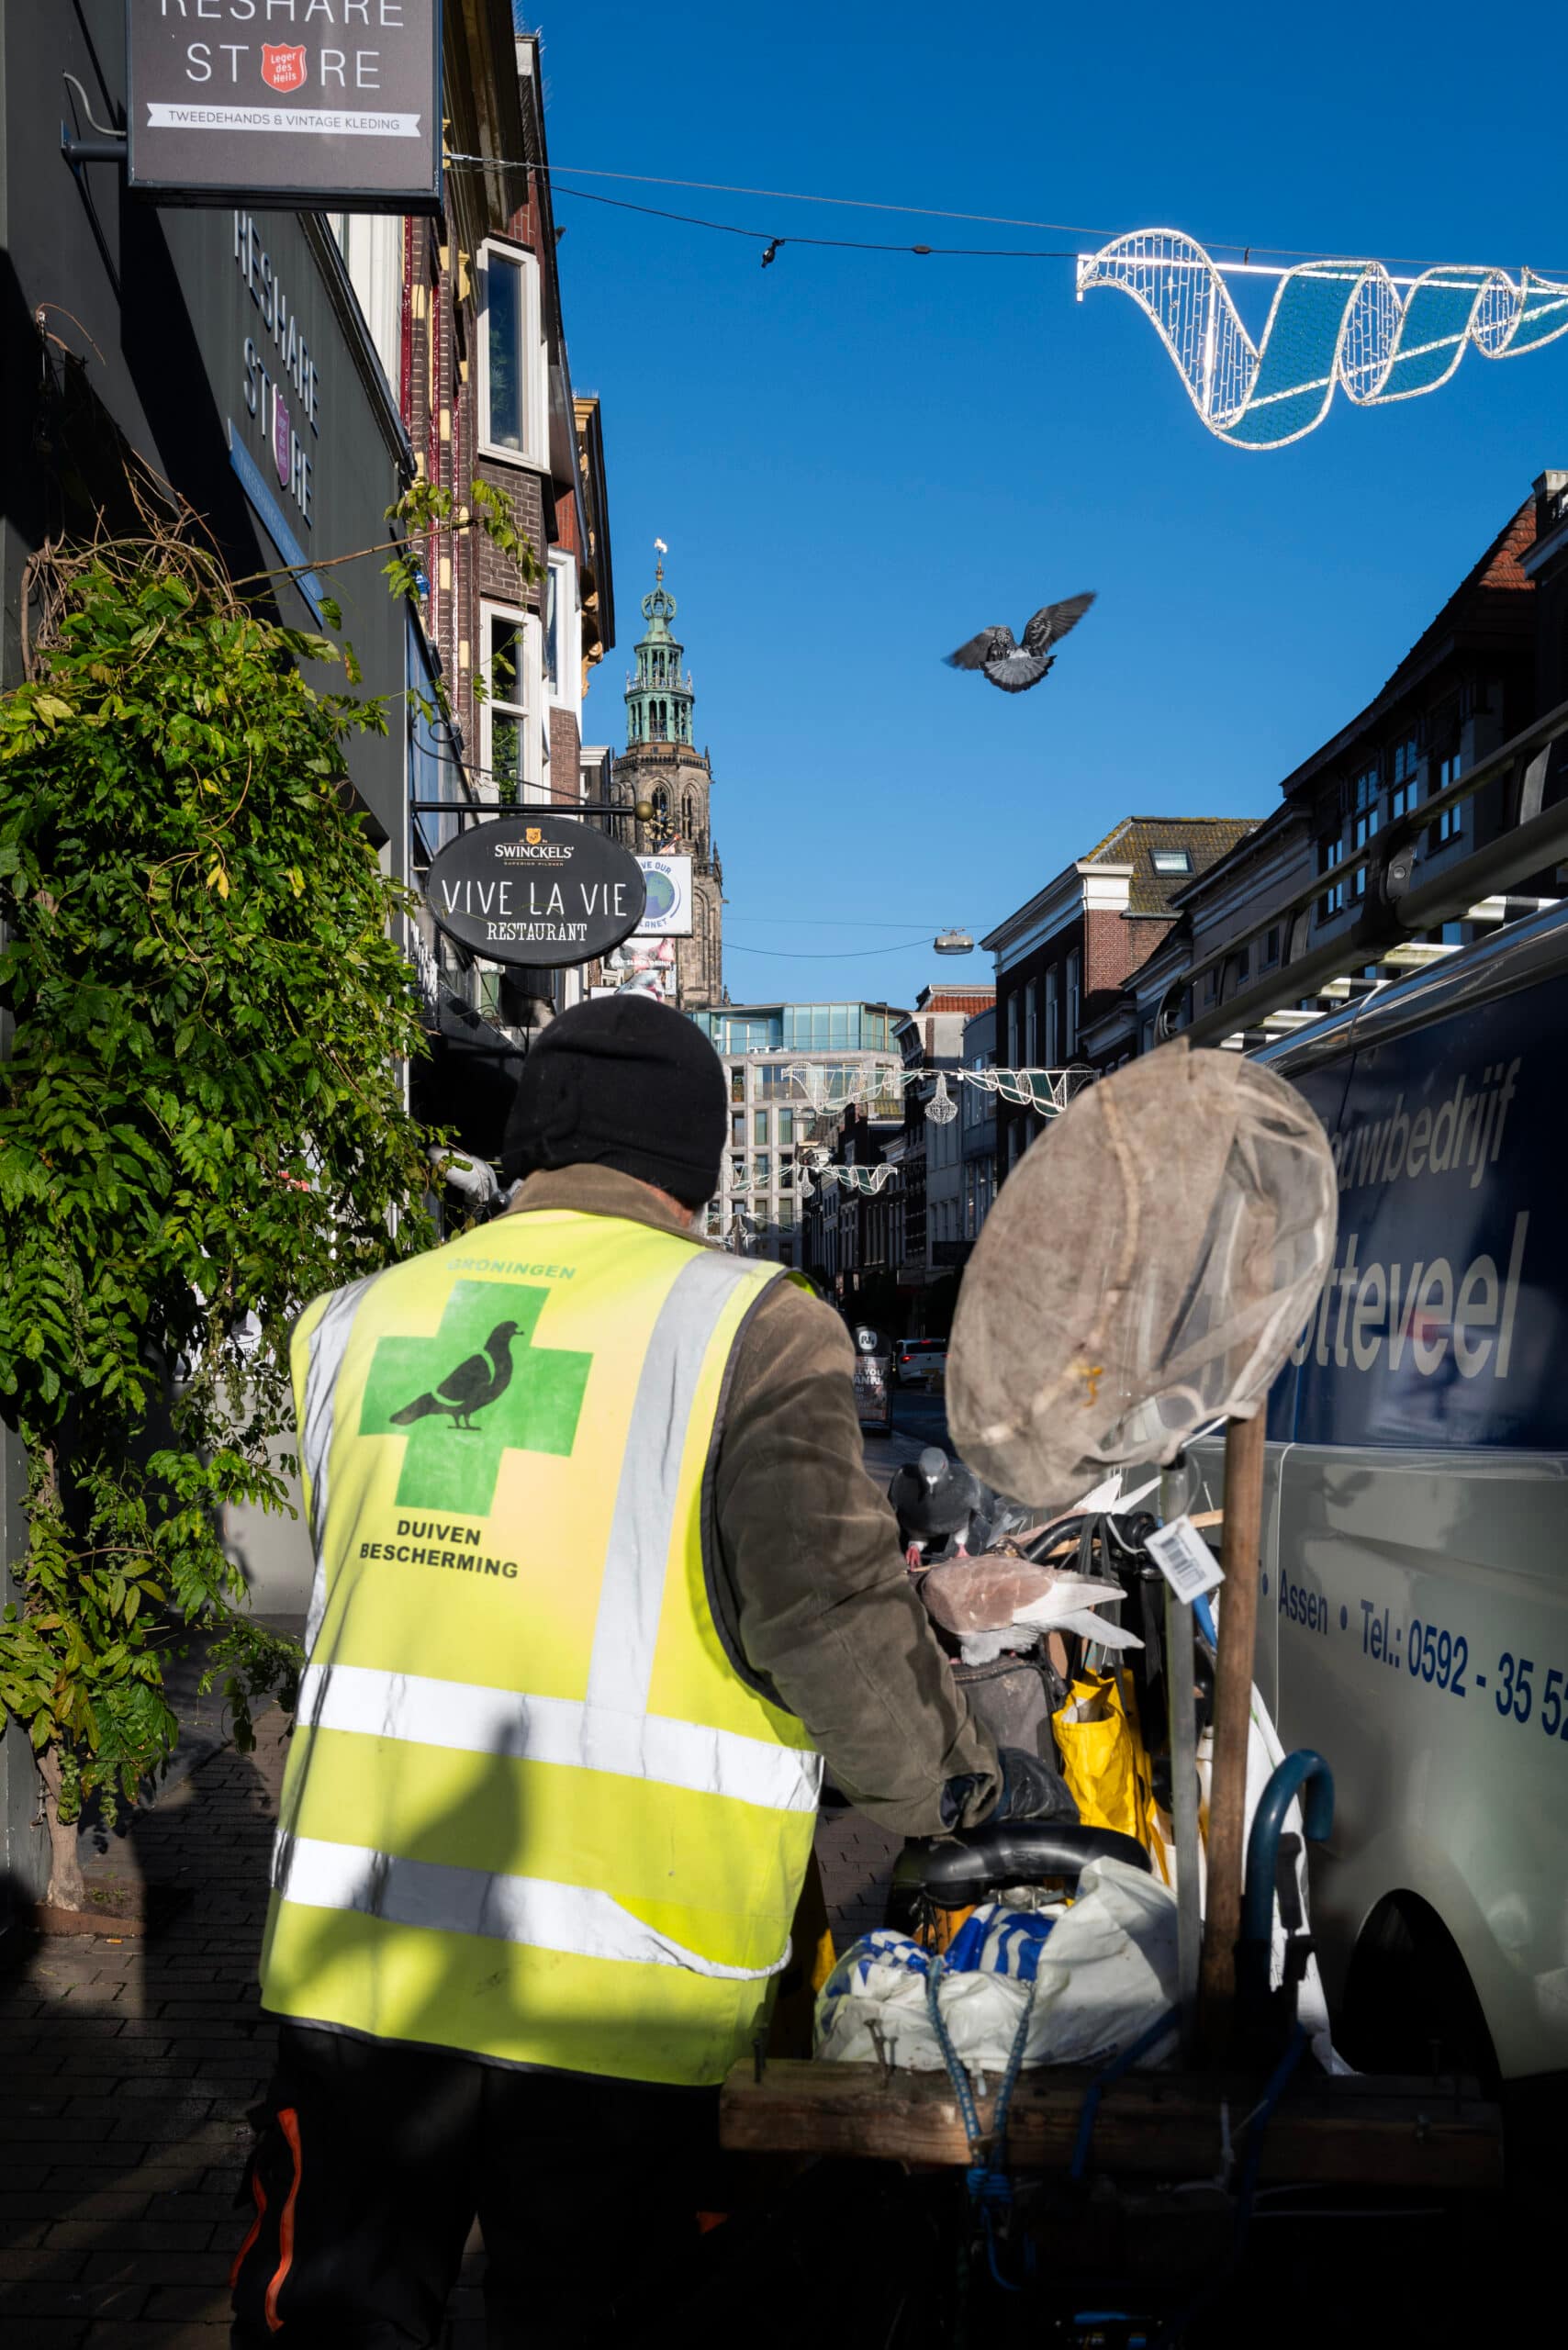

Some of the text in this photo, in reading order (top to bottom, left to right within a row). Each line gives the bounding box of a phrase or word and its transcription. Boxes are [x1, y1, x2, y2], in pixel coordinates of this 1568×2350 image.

[271, 52, 297, 64] Leger
[275, 63, 292, 73] des
[273, 71, 297, 84] Heils
[168, 110, 400, 130] TWEEDEHANDS & VINTAGE KLEDING
[655, 862, 672, 875] OUR
[442, 878, 628, 917] VIVE LA VIE
[487, 922, 588, 942] RESTAURANT
[638, 918, 667, 930] LANET
[1323, 1058, 1522, 1193] ouwbedrijf
[446, 1258, 577, 1280] GRONINGEN
[396, 1519, 482, 1546] DUIVEN
[359, 1542, 520, 1580] BESCHERMING
[1278, 1568, 1328, 1636] Assen
[1360, 1598, 1402, 1669] Tel.:
[1407, 1618, 1469, 1698] 0592
[1495, 1651, 1535, 1724] 35
